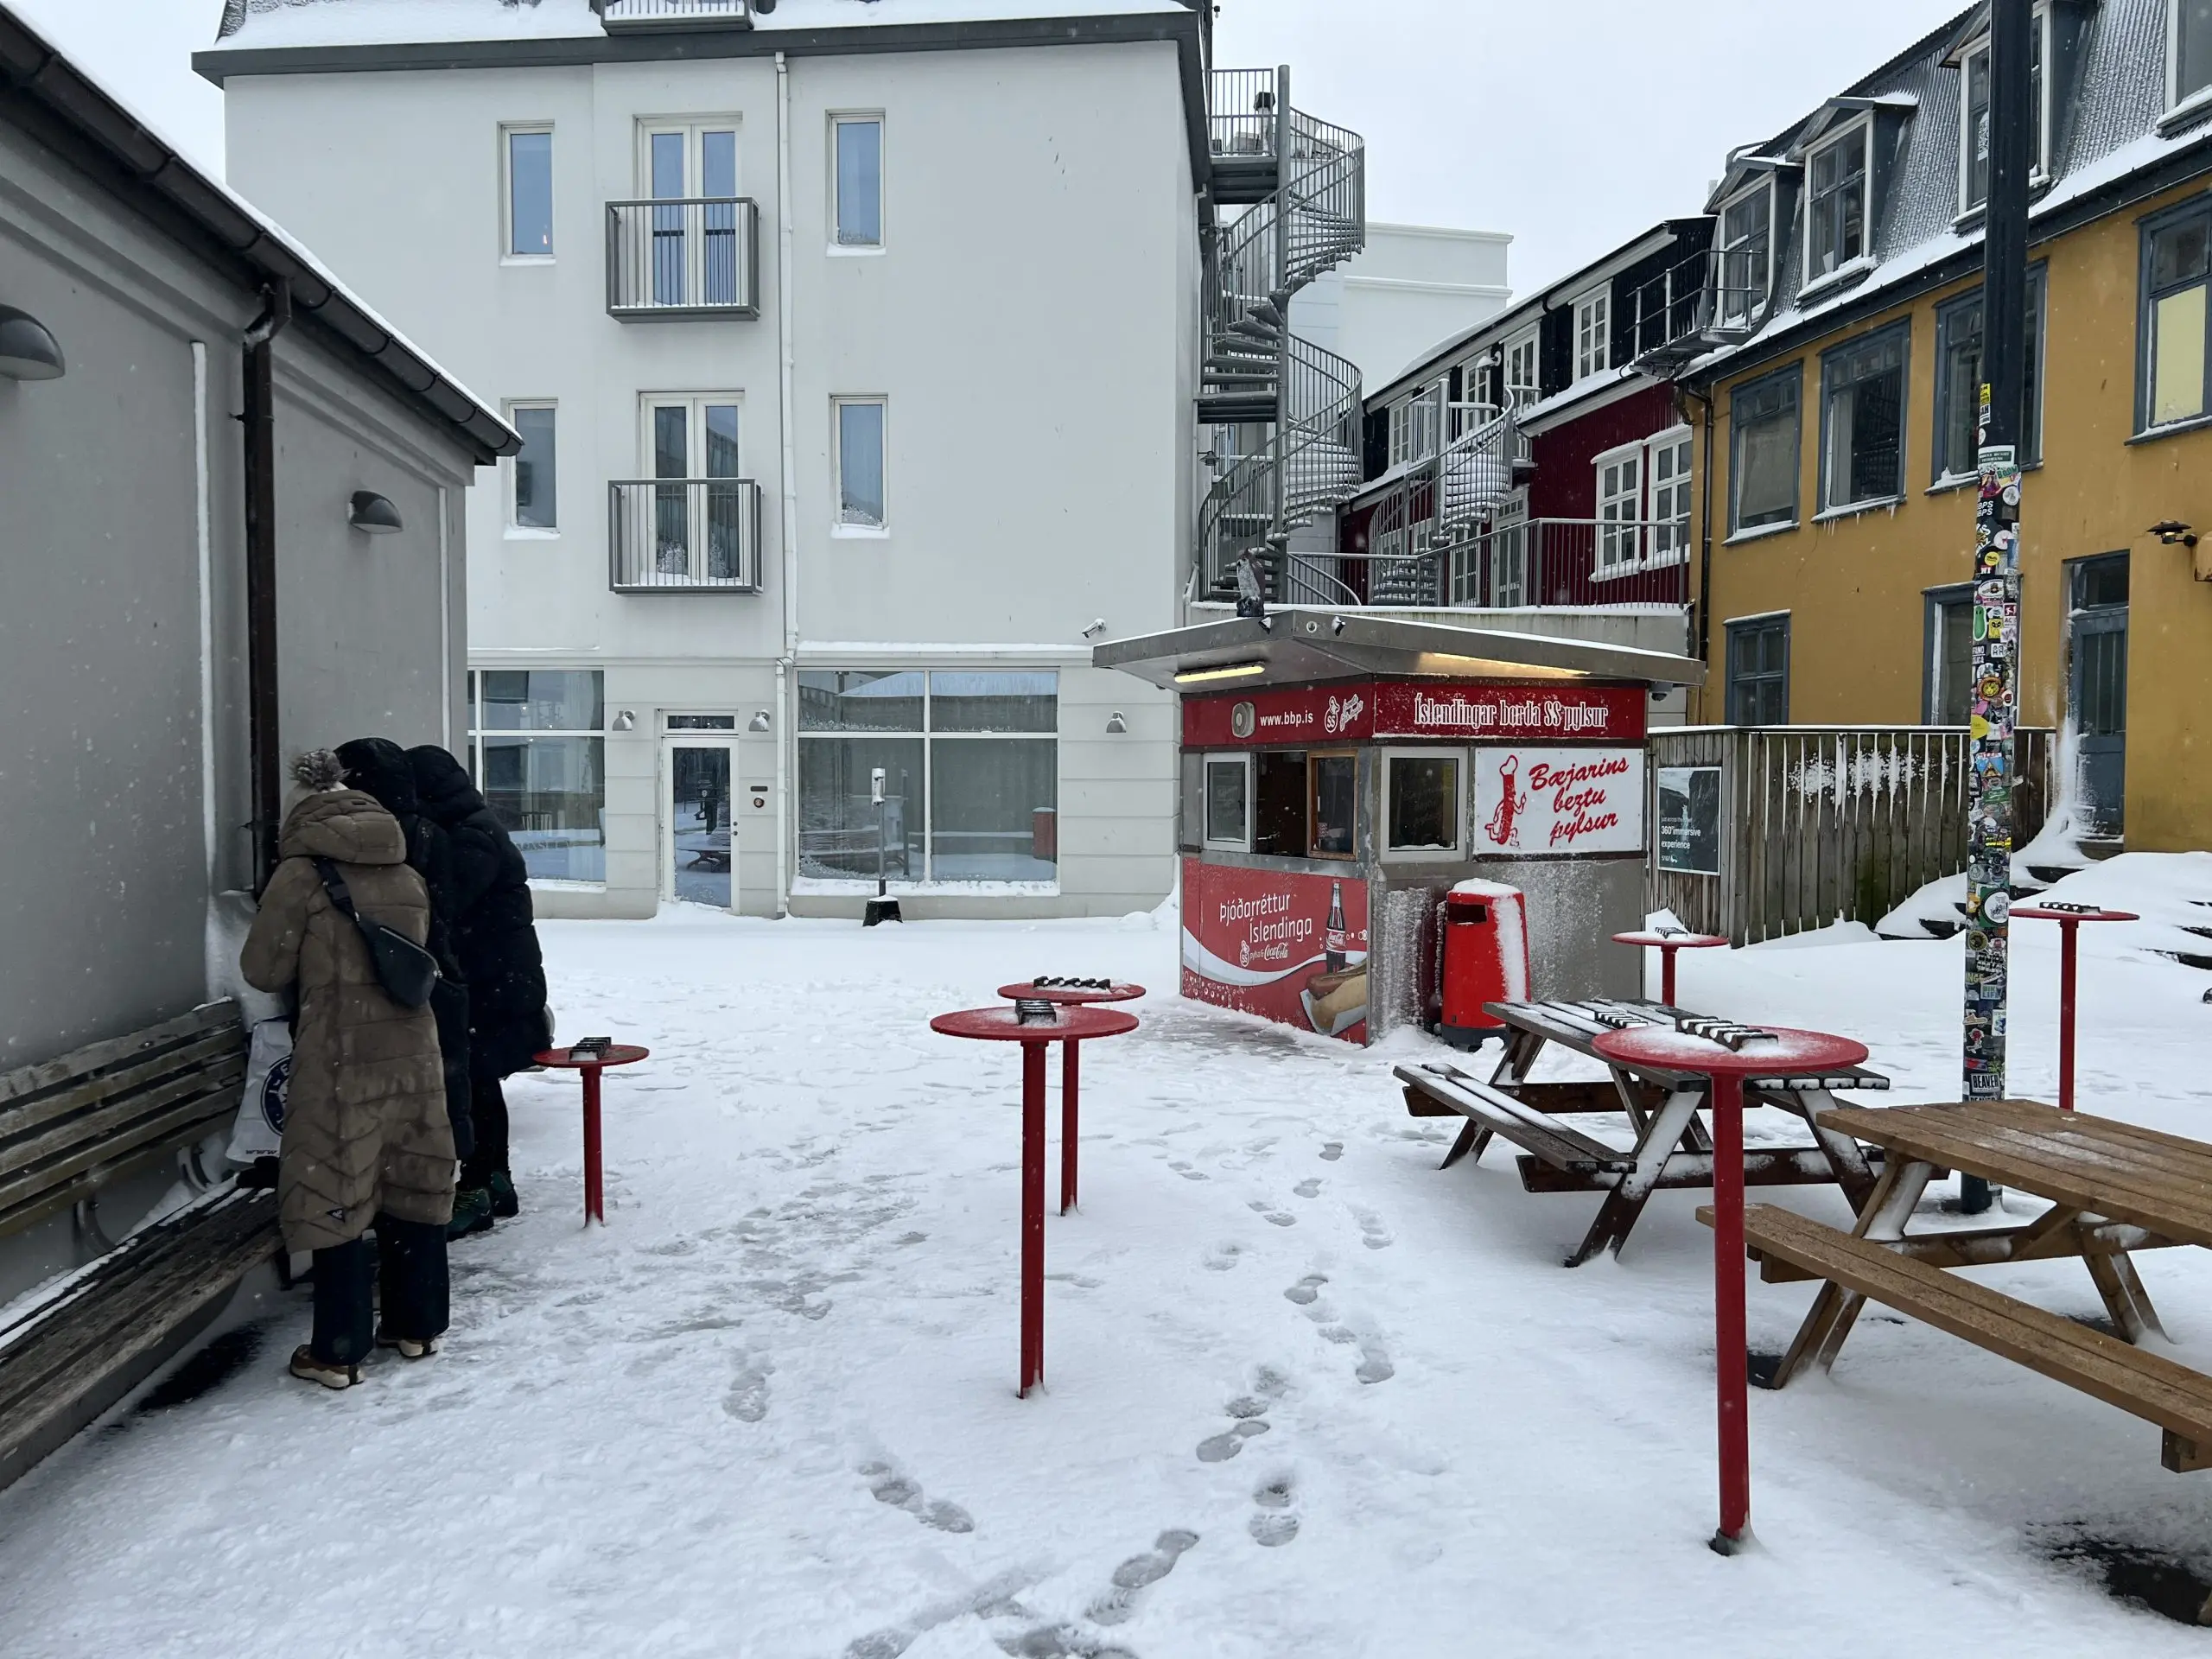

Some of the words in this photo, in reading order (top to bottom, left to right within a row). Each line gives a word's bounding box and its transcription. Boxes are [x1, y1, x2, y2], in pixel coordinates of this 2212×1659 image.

[1260, 709, 1313, 728] www.bbp.is
[1326, 715, 1336, 728] SS
[1414, 692, 1497, 729] Íslendingar
[1543, 700, 1561, 727] SS
[1563, 701, 1609, 731] pylsur
[1529, 757, 1629, 791] Bæjarins
[1554, 786, 1606, 817] beztu
[1549, 810, 1618, 847] pylsur
[1661, 840, 1691, 849] experience
[1249, 918, 1313, 944] Íslendinga
[1973, 1074, 1999, 1088] BEAVER
